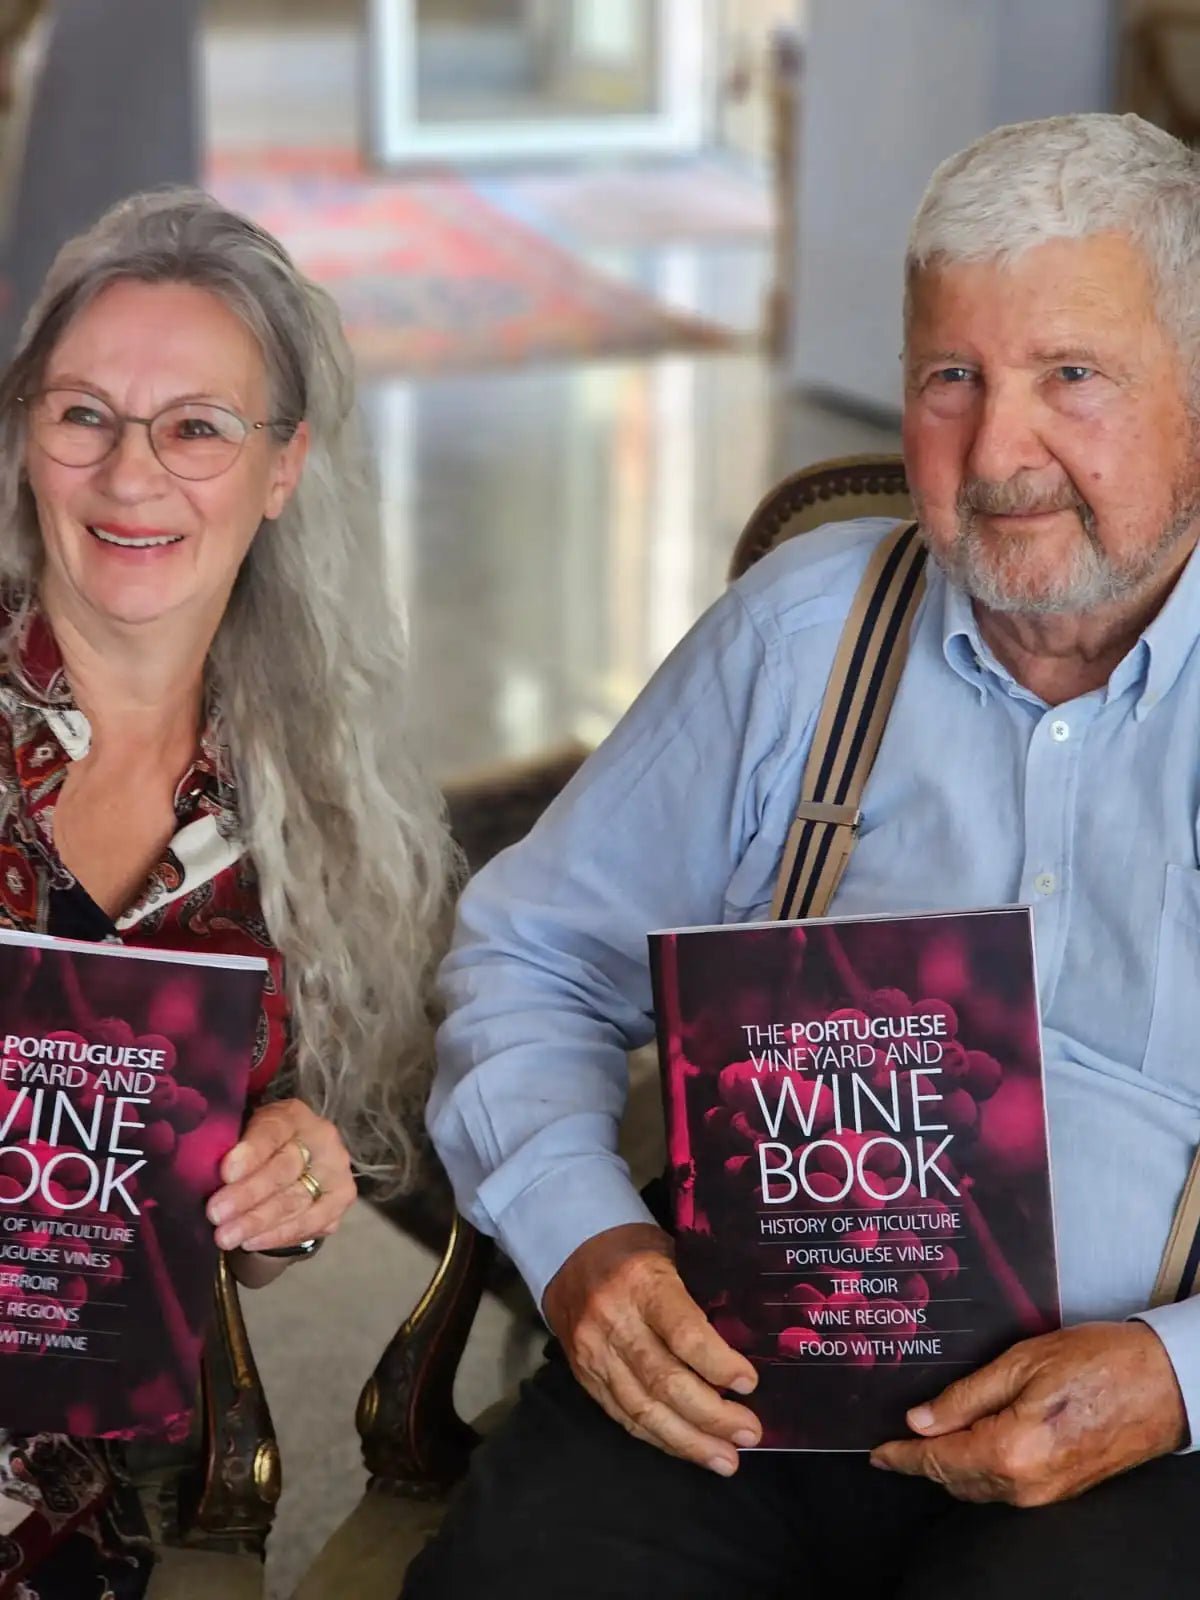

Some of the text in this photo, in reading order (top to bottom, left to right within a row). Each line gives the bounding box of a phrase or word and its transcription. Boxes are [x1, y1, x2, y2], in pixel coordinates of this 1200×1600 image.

[741, 1014, 947, 1045] THE PORTUGUESE
[3, 1035, 167, 1070] PORTUGUESE
[749, 1040, 943, 1073] VINEYARD AND
[0, 1058, 156, 1095] EYARD AND
[751, 1068, 949, 1138] WINE
[758, 1134, 961, 1204] BOOK
[3, 1217, 136, 1242] OF VITICULTURE
[760, 1213, 961, 1234] HISTORY OF VITICULTURE
[63, 1250, 111, 1268] VINES
[786, 1245, 944, 1265] PORTUGUESE VINES
[0, 1272, 59, 1292] ERROIR
[830, 1278, 898, 1295] TERROIR
[7, 1302, 80, 1321] REGIONS
[808, 1308, 927, 1326] WINE REGIONS
[44, 1334, 88, 1350] WINE
[799, 1339, 942, 1356] FOOD WITH WINE
